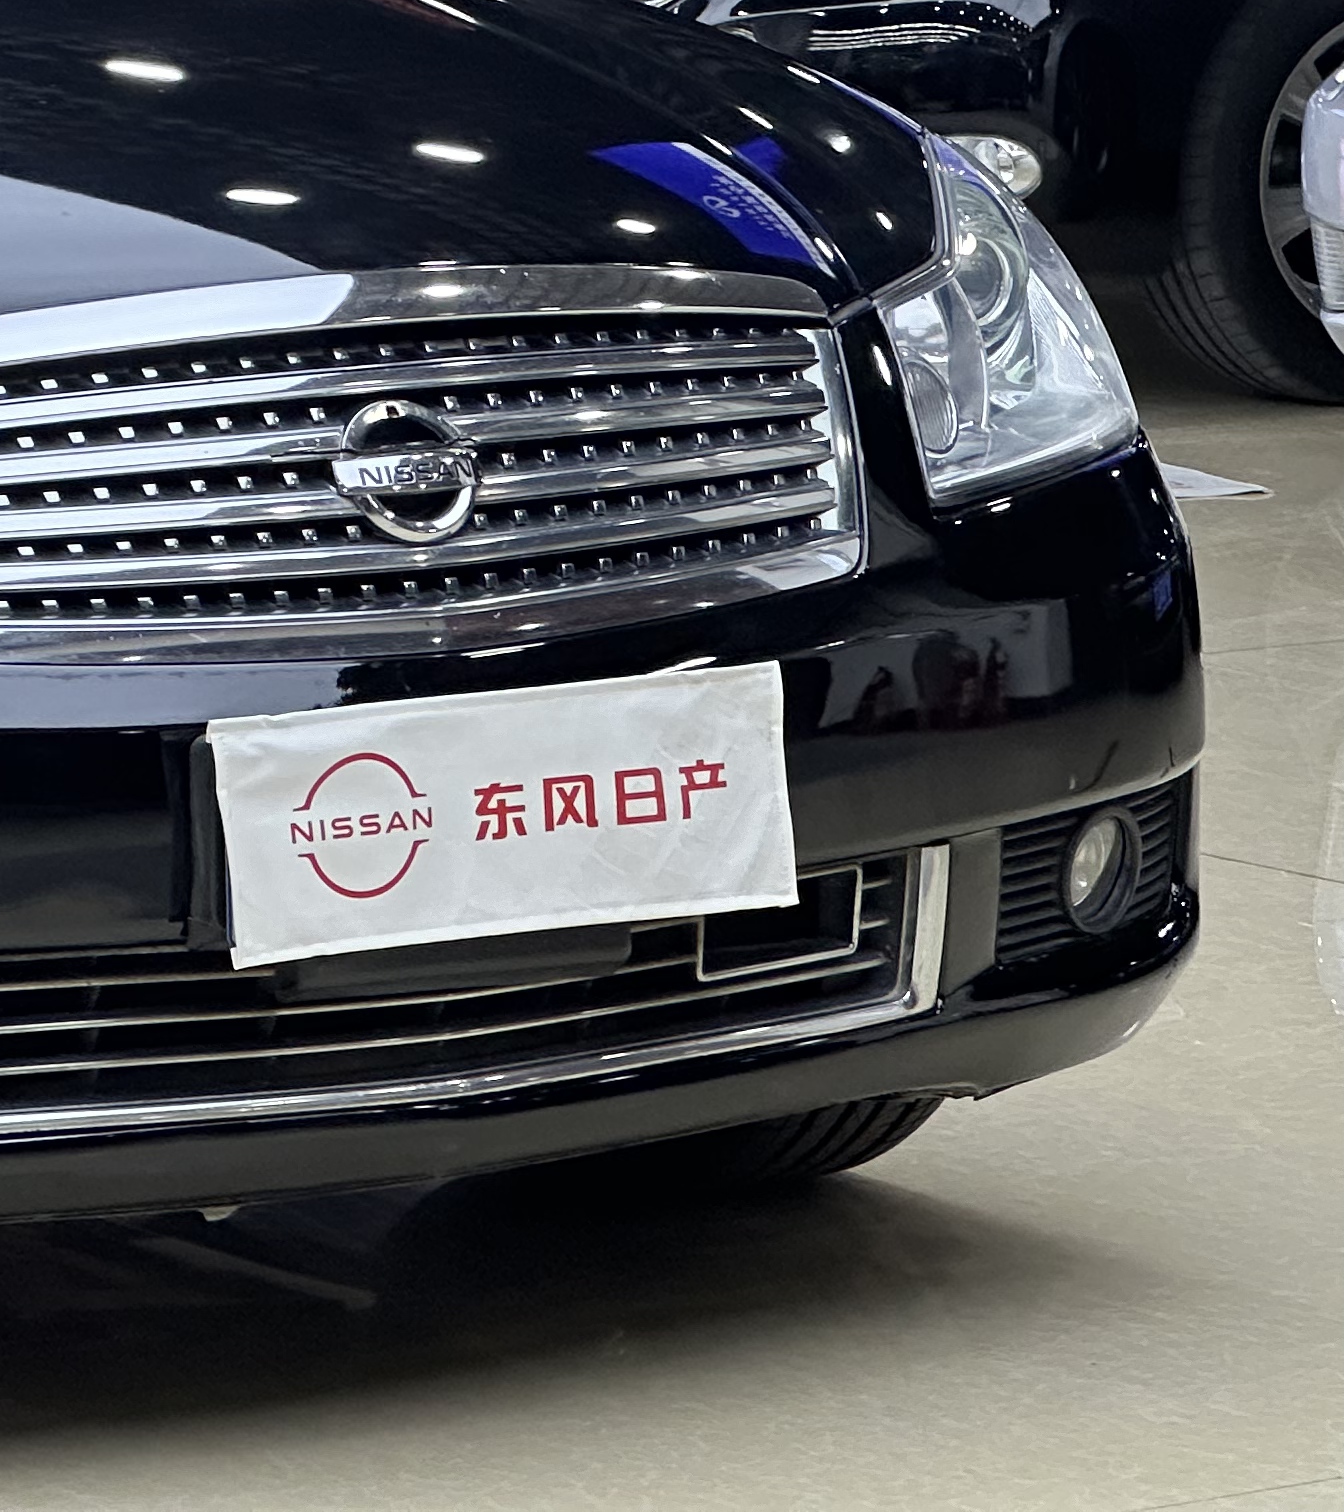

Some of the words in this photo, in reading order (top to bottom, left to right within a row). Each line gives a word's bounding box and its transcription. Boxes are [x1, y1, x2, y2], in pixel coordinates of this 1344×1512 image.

[357, 457, 475, 488] NISSAN
[290, 805, 434, 846] NISSAN
[473, 758, 728, 842] 东风日产
